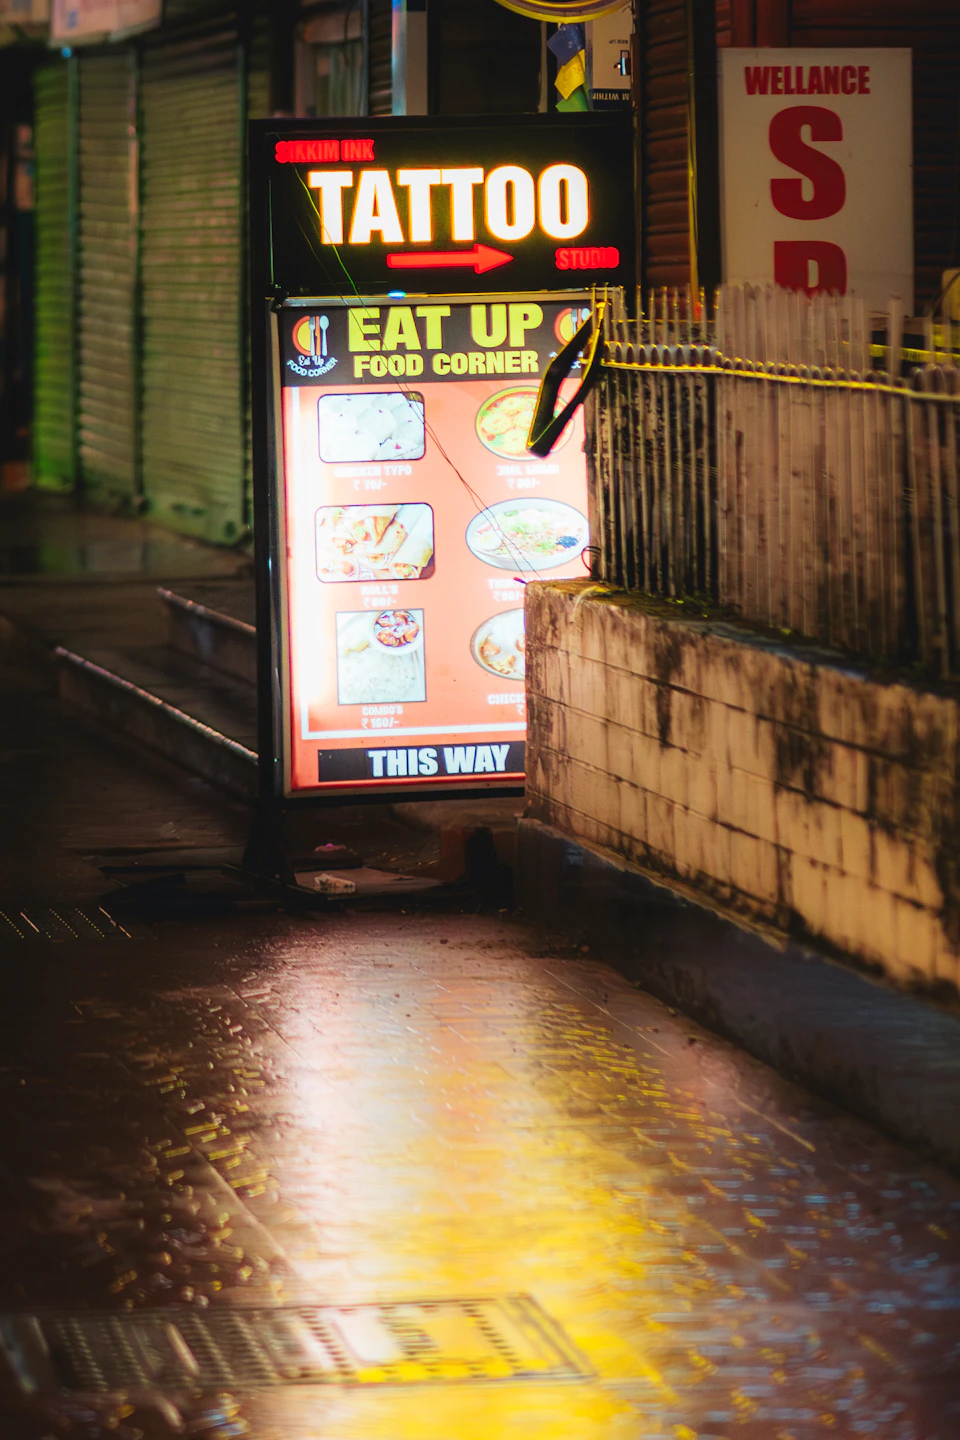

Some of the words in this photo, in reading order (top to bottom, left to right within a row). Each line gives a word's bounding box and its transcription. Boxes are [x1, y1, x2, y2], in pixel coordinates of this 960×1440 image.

[744, 66, 870, 96] WELLANCE
[341, 139, 375, 162] INK
[308, 164, 589, 245] TATTOO
[348, 305, 451, 352] EAT
[471, 303, 544, 348] UP
[286, 359, 308, 376] FOOD
[307, 357, 338, 377] CORNER
[353, 354, 423, 378] FOOD
[432, 350, 539, 375] CORNER
[384, 464, 412, 476] TYPO
[368, 748, 439, 777] THIS
[444, 744, 510, 774] WAY
